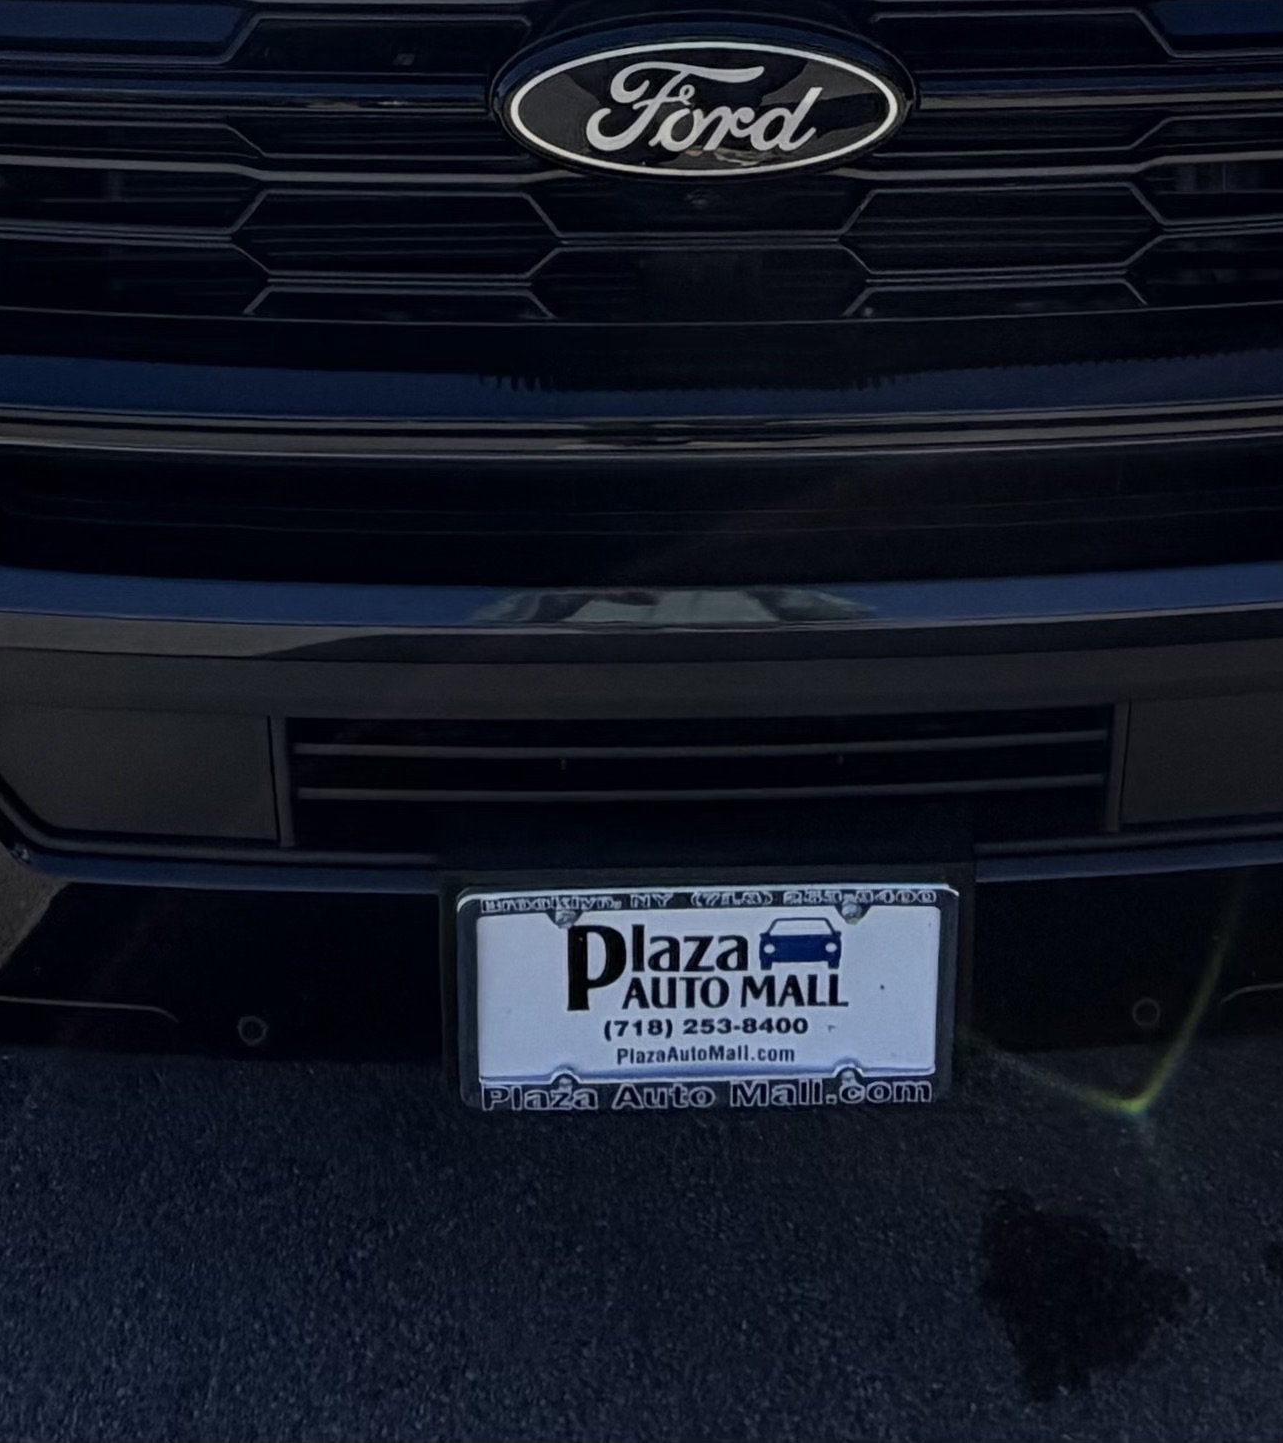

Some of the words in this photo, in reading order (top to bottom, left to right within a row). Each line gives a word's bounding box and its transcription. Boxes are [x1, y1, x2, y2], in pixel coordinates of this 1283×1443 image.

[585, 60, 823, 152] Ford
[630, 892, 674, 908] NY
[567, 924, 749, 1011] Plaza
[621, 976, 730, 1010] AUTO
[740, 973, 850, 1007] MALL
[604, 1018, 674, 1042] (718)
[682, 1017, 809, 1036] 253-8400
[616, 1044, 795, 1065] PlazaAutoMall.com
[481, 1084, 599, 1112] Plaza
[611, 1082, 717, 1109] Auto
[729, 1077, 933, 1107] Mall.com
